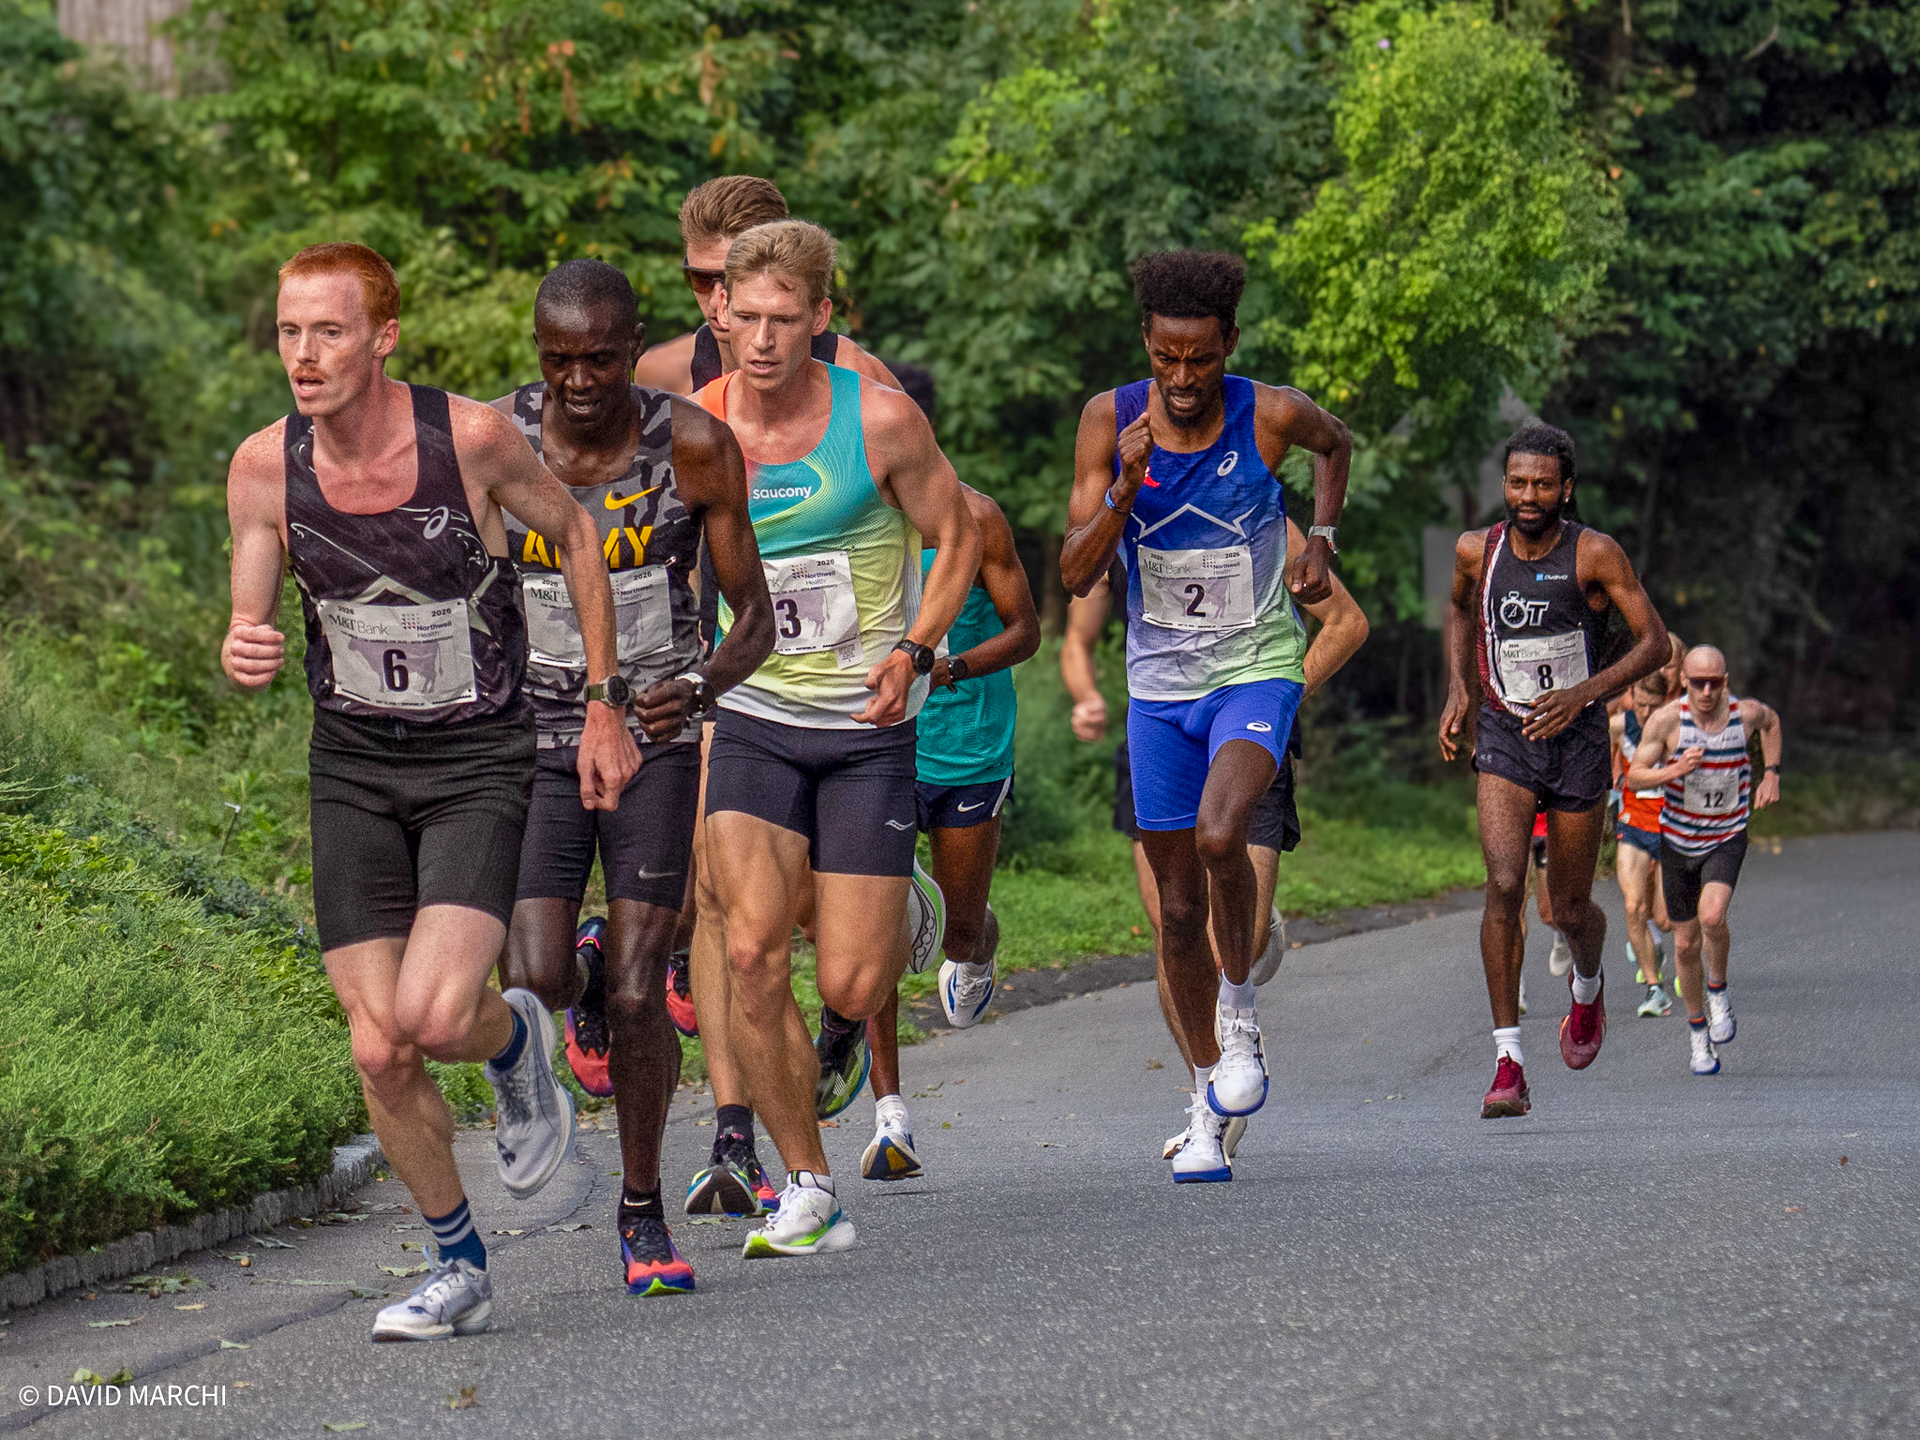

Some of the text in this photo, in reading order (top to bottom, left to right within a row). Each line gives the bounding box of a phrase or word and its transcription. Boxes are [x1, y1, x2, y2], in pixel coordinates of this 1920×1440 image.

[753, 486, 812, 501] saucony
[1225, 551, 1240, 559] 2026
[817, 559, 835, 567] 2026
[1143, 559, 1191, 575] M&T Bank
[1213, 562, 1241, 570] Northwell
[633, 571, 652, 581] 2026
[805, 570, 836, 579] Northwell
[806, 578, 825, 586] Health
[531, 586, 559, 603] M&T
[621, 584, 654, 596] Northwell
[1184, 583, 1207, 618] 2
[337, 605, 355, 615] 2026
[431, 608, 452, 617] 2026
[775, 598, 802, 639] 3
[328, 614, 389, 635] M&T Bank
[416, 621, 452, 631] Northwell
[417, 630, 441, 638] Health
[383, 649, 409, 692] 6
[1537, 664, 1554, 690] 8
[1703, 791, 1725, 808] 12
